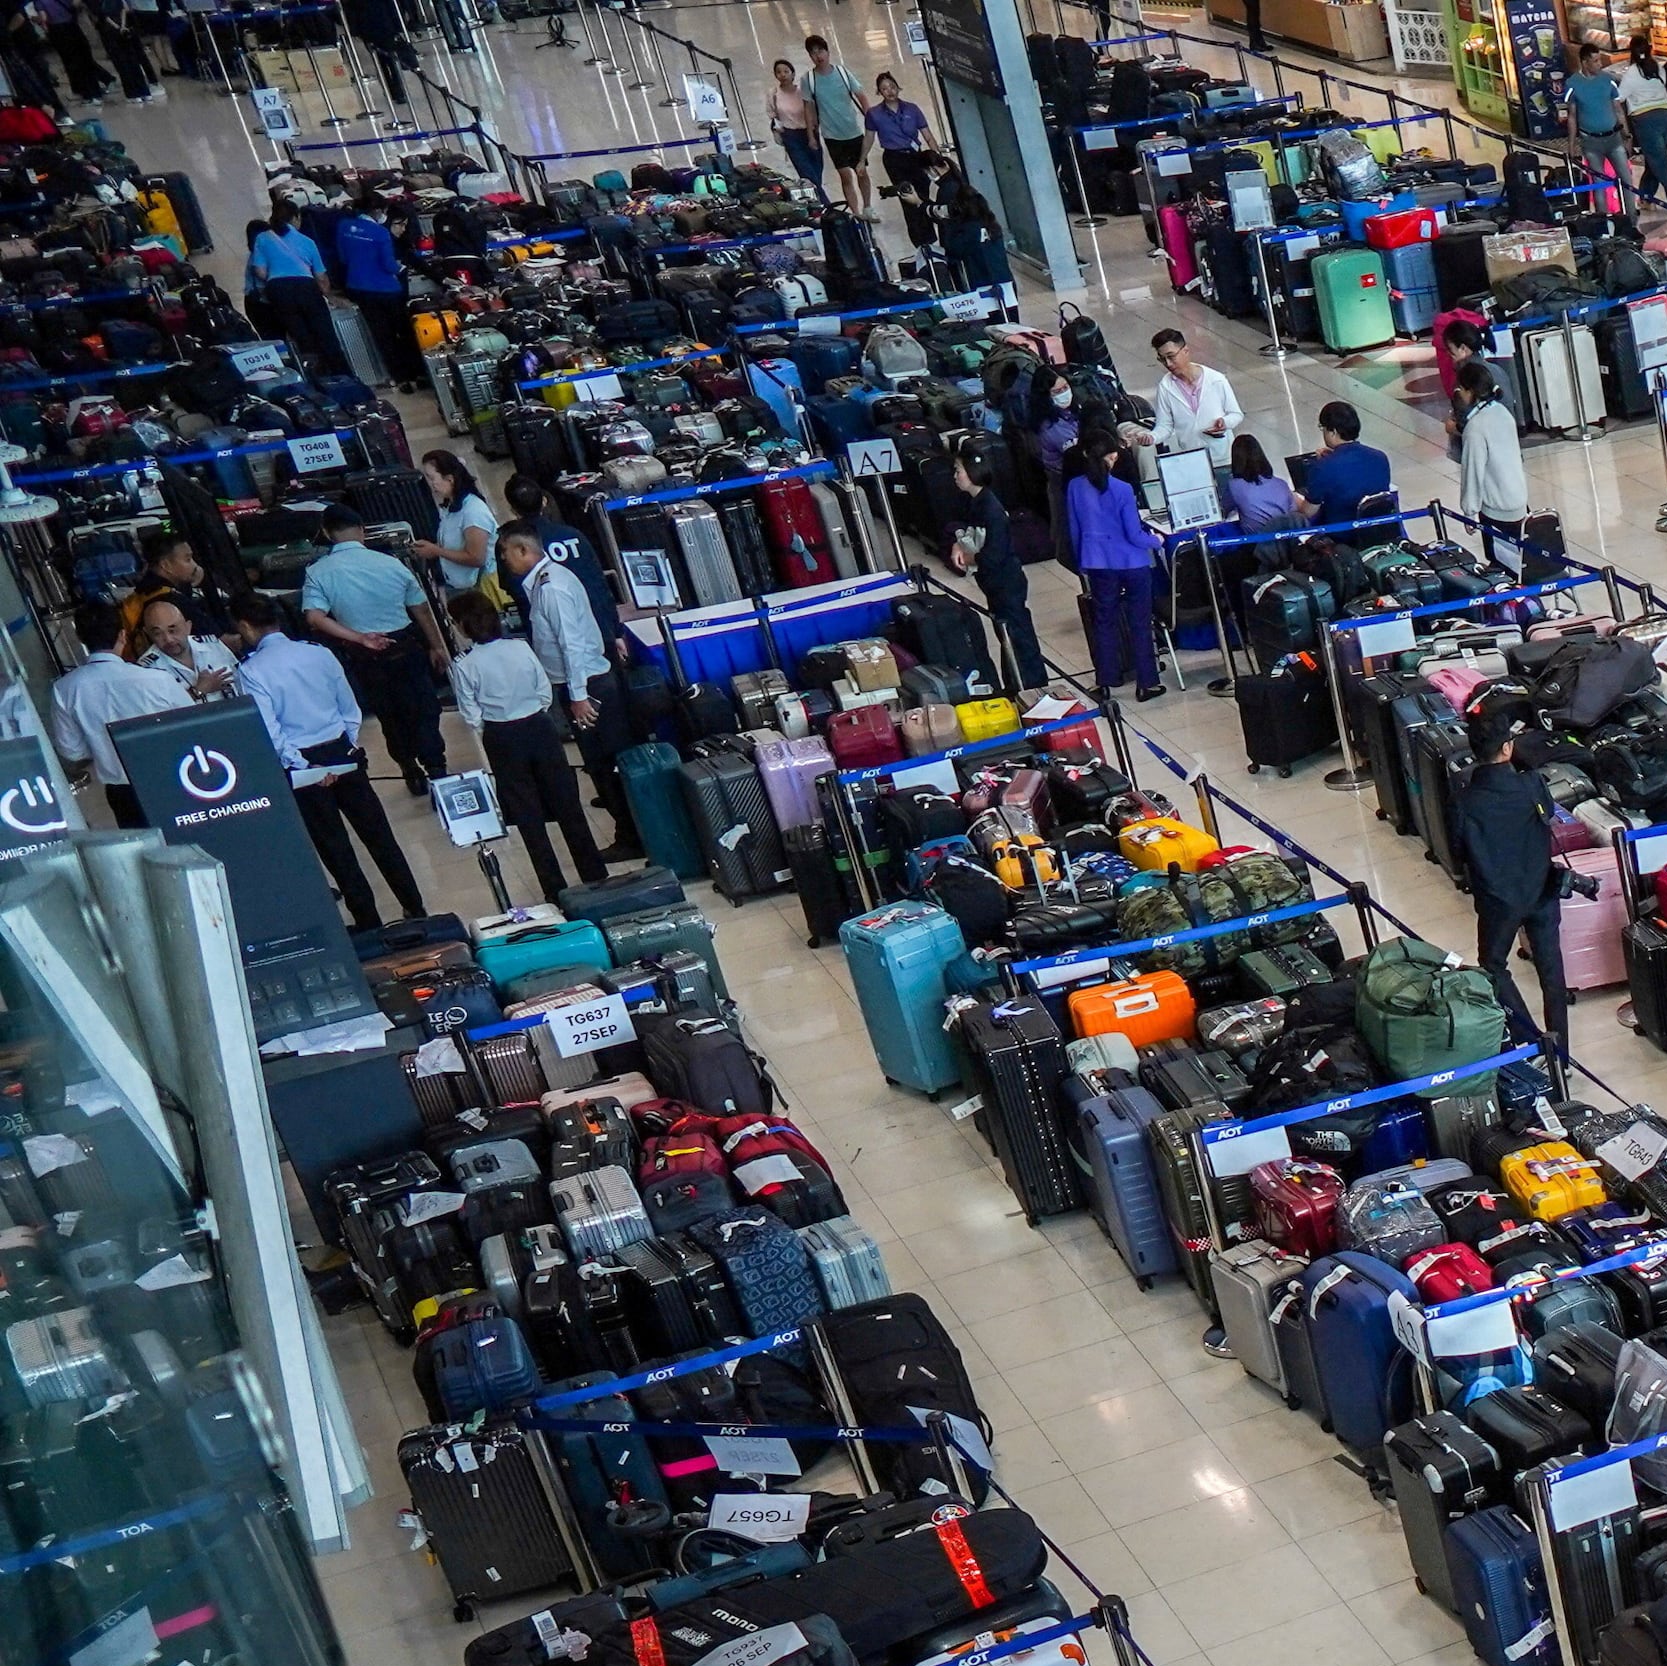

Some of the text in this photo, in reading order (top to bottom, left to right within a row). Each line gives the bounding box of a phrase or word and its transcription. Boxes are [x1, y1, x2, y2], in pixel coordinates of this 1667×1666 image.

[1511, 11, 1555, 24] MATCHA
[263, 96, 277, 105] A7
[702, 94, 716, 104] A6
[877, 307, 890, 315] AOT
[243, 352, 271, 365] TG316
[300, 441, 330, 453] TG408
[304, 453, 334, 465] 27SEP
[859, 450, 892, 475] A7
[765, 472, 781, 481] AOT
[697, 483, 711, 492] AOT
[626, 496, 642, 504] AOT
[548, 538, 580, 561] OT
[840, 587, 860, 598] AOT
[1541, 582, 1557, 592] AOT
[1025, 725, 1043, 736] AOT
[175, 797, 271, 826] FREE CHARGING
[1152, 935, 1174, 947] AOT
[565, 1007, 611, 1027] TG637
[573, 1025, 617, 1045] 27SEP
[1432, 1072, 1452, 1084] AOT
[1327, 1099, 1349, 1111] AOT
[1218, 1128, 1242, 1139] AOT
[1626, 1140, 1653, 1165] TG643
[774, 1330, 800, 1343] AOT
[646, 1367, 674, 1383] AOT
[837, 1425, 863, 1441] AOT
[728, 1510, 795, 1522] TG657
[711, 1607, 760, 1632] mono
[722, 1635, 764, 1660] TG937
[747, 1641, 773, 1663] SEP
